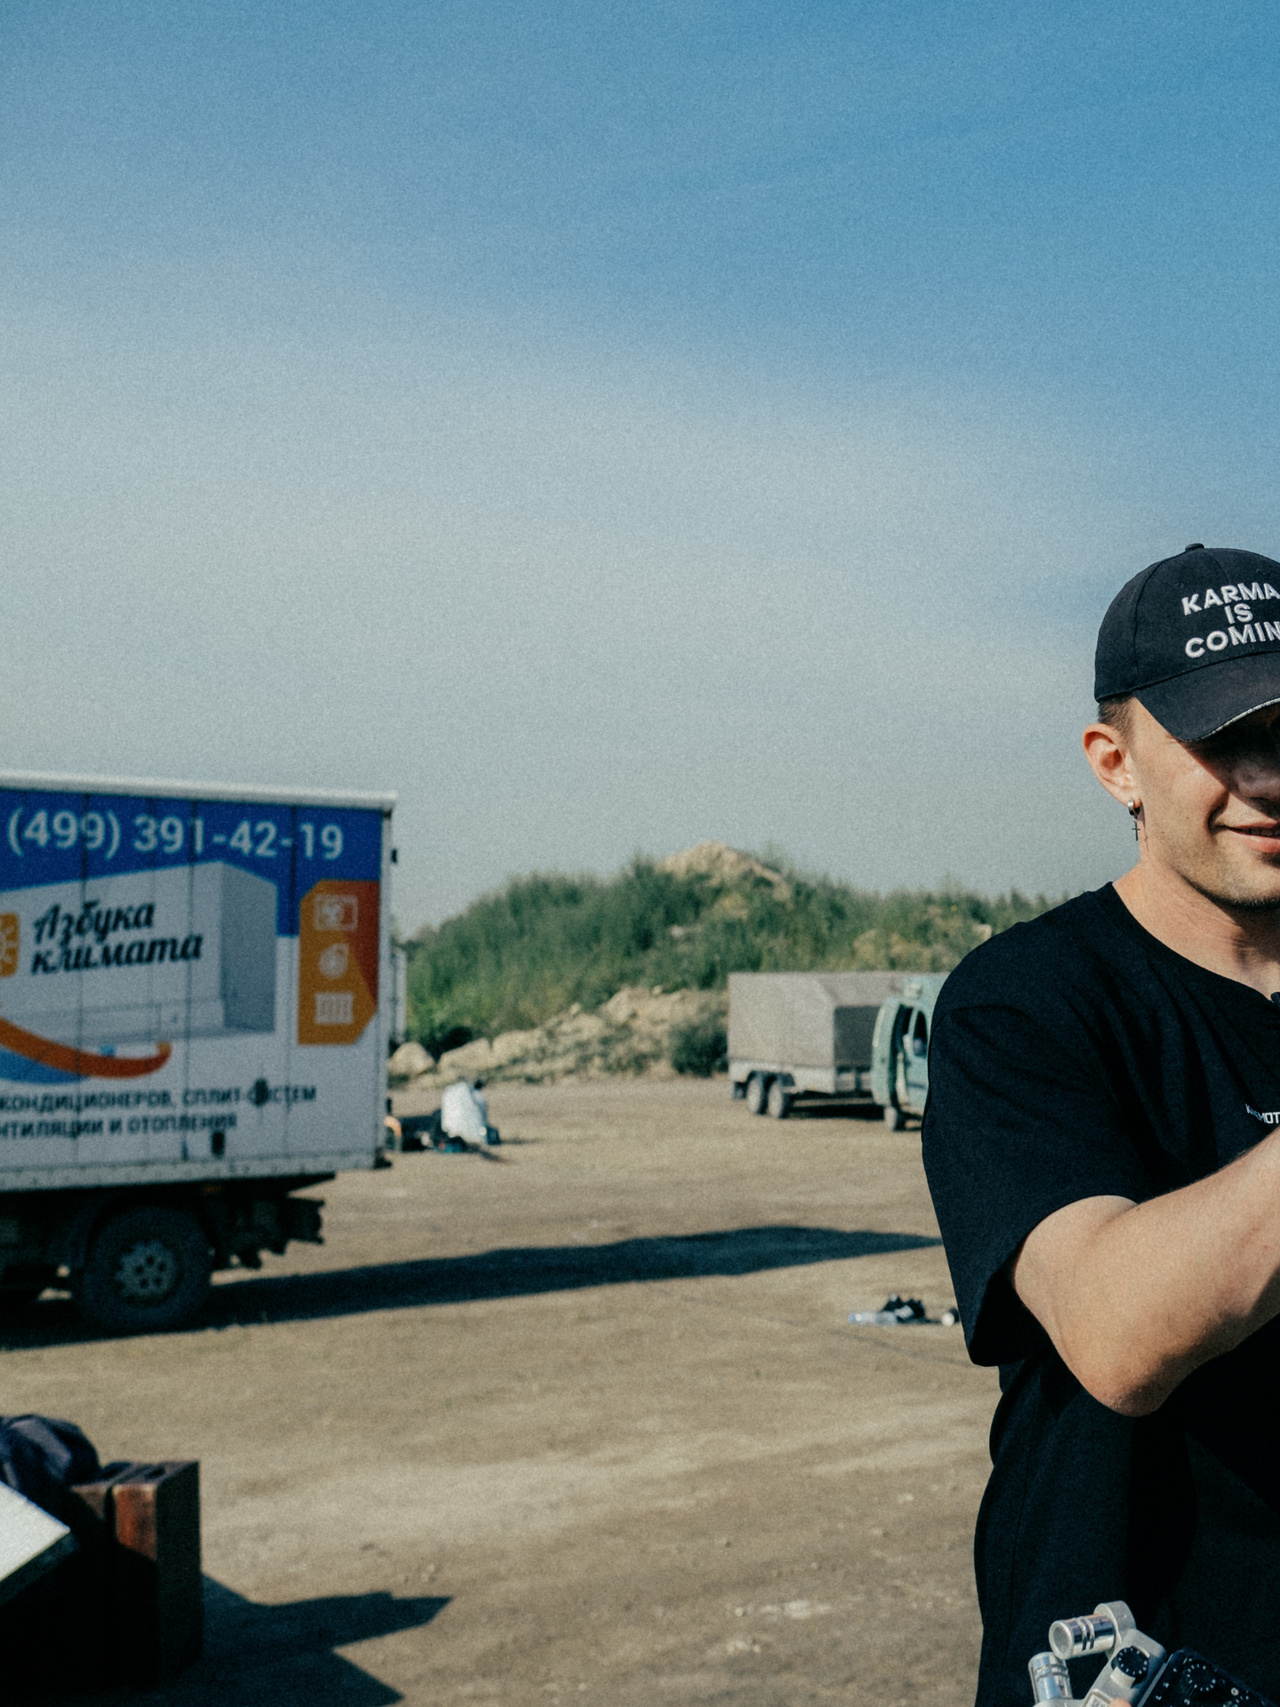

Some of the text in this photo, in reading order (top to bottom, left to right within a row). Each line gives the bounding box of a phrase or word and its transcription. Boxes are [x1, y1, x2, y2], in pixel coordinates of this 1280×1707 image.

[1224, 603, 1253, 624] IS
[8, 807, 344, 861] (499) 391-42-19
[33, 900, 155, 948] Азбука
[109, 1118, 122, 1134] И
